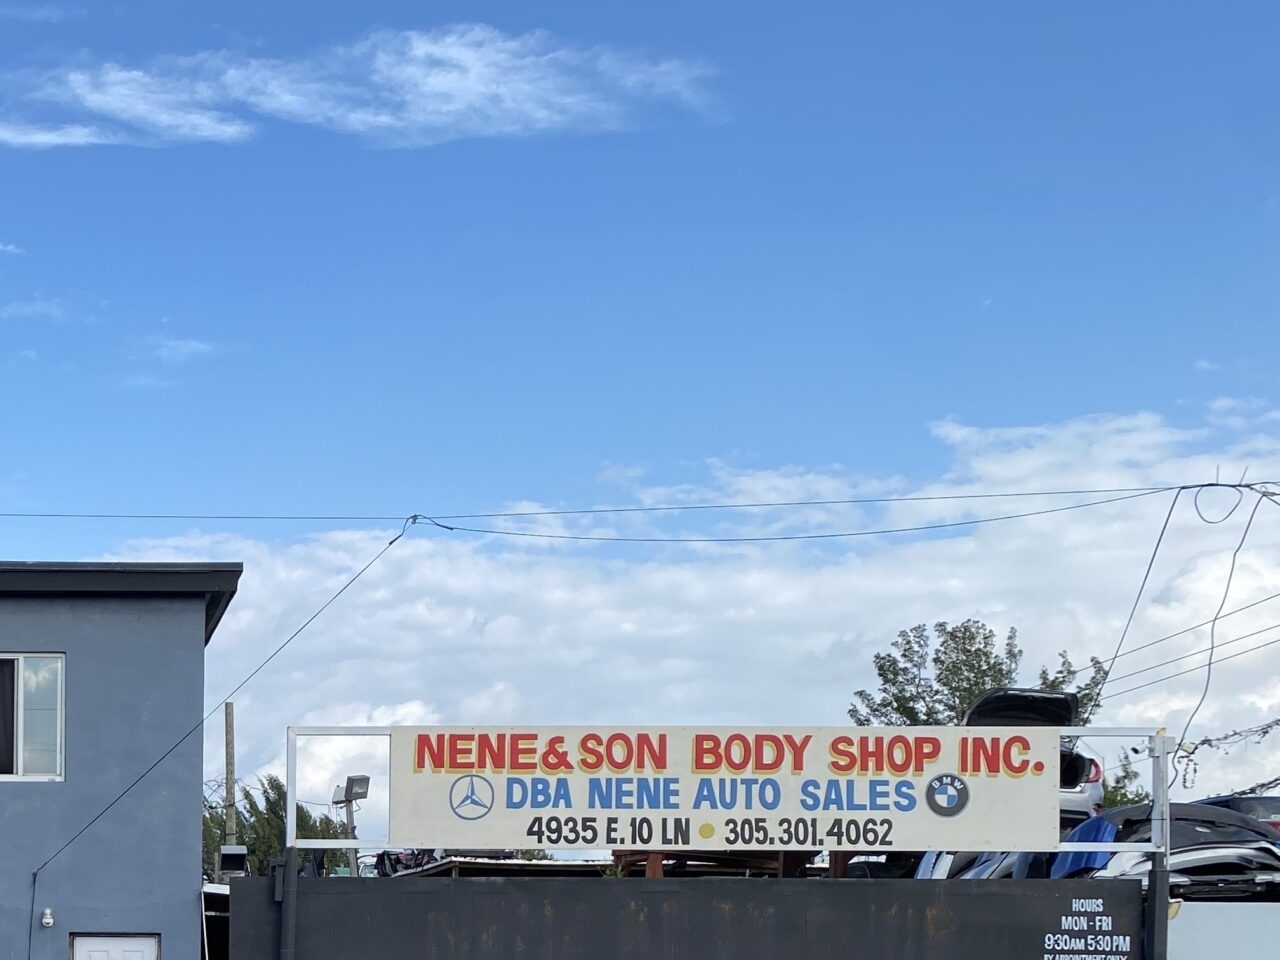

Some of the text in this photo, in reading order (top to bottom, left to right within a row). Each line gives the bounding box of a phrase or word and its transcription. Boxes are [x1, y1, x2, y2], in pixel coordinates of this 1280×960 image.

[691, 733, 813, 775] BODY
[827, 735, 942, 777] SHOP
[958, 735, 1045, 778] INC.
[505, 777, 917, 811] DBA NENE AUTO SALES
[931, 776, 964, 790] BMW
[526, 816, 598, 845] 4935
[661, 817, 690, 845] LN
[723, 817, 893, 846] 305.301.4062
[1072, 898, 1104, 912] HOURS
[1061, 916, 1087, 930] MON
[1095, 916, 1112, 931] FRI
